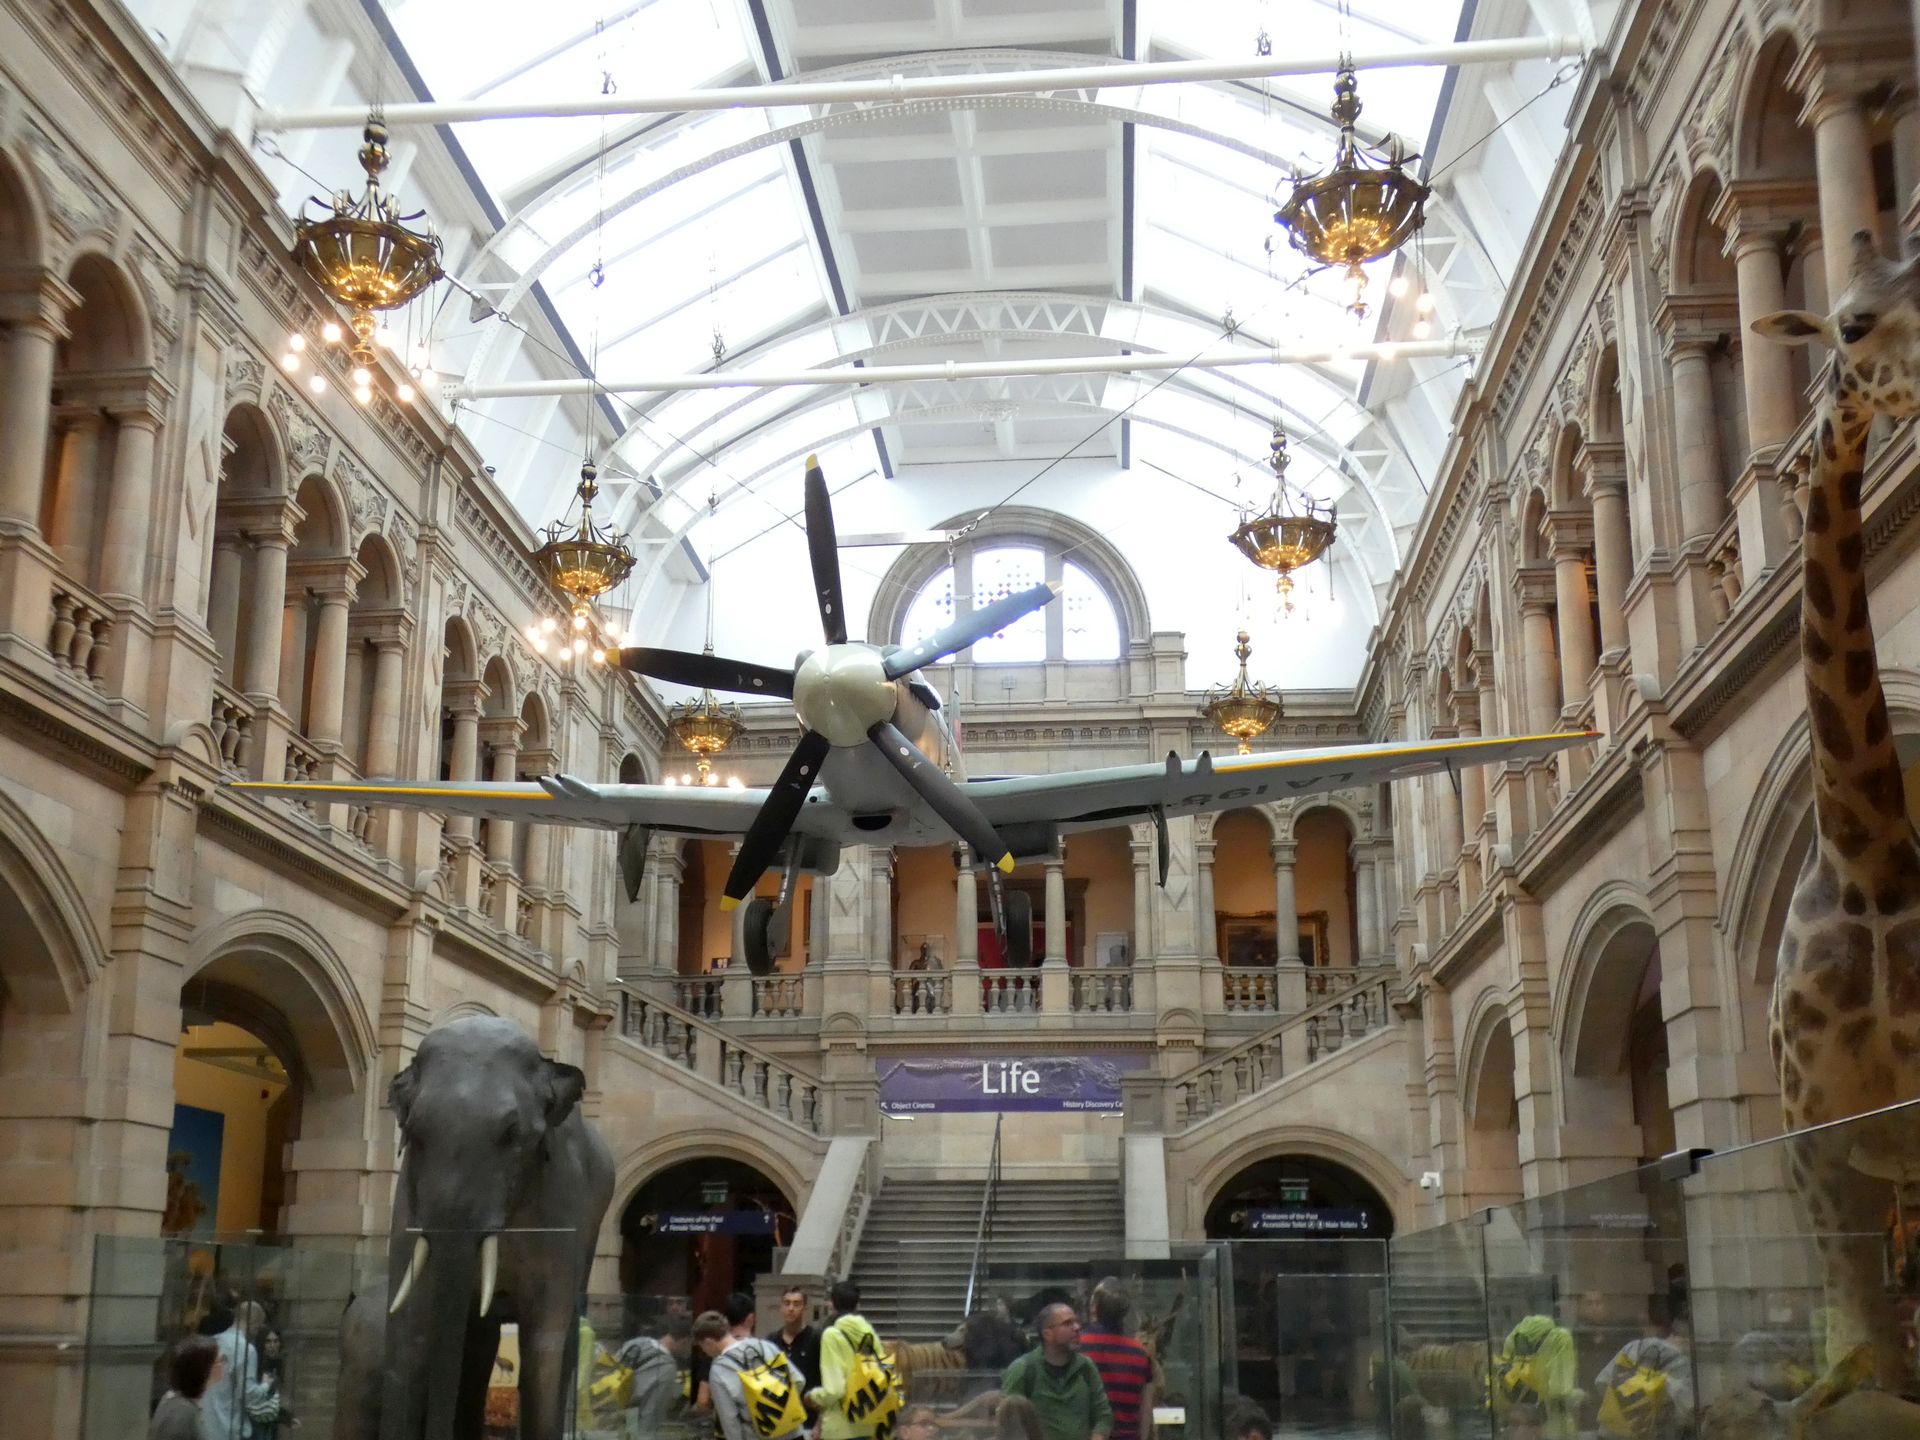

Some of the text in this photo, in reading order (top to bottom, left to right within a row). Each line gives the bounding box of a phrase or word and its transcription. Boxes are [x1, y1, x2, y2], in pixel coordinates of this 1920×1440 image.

[982, 1061, 1041, 1094] Life
[891, 1101, 936, 1110] Object Cinema
[1063, 1100, 1085, 1109] History
[1085, 1100, 1114, 1109] Discovery
